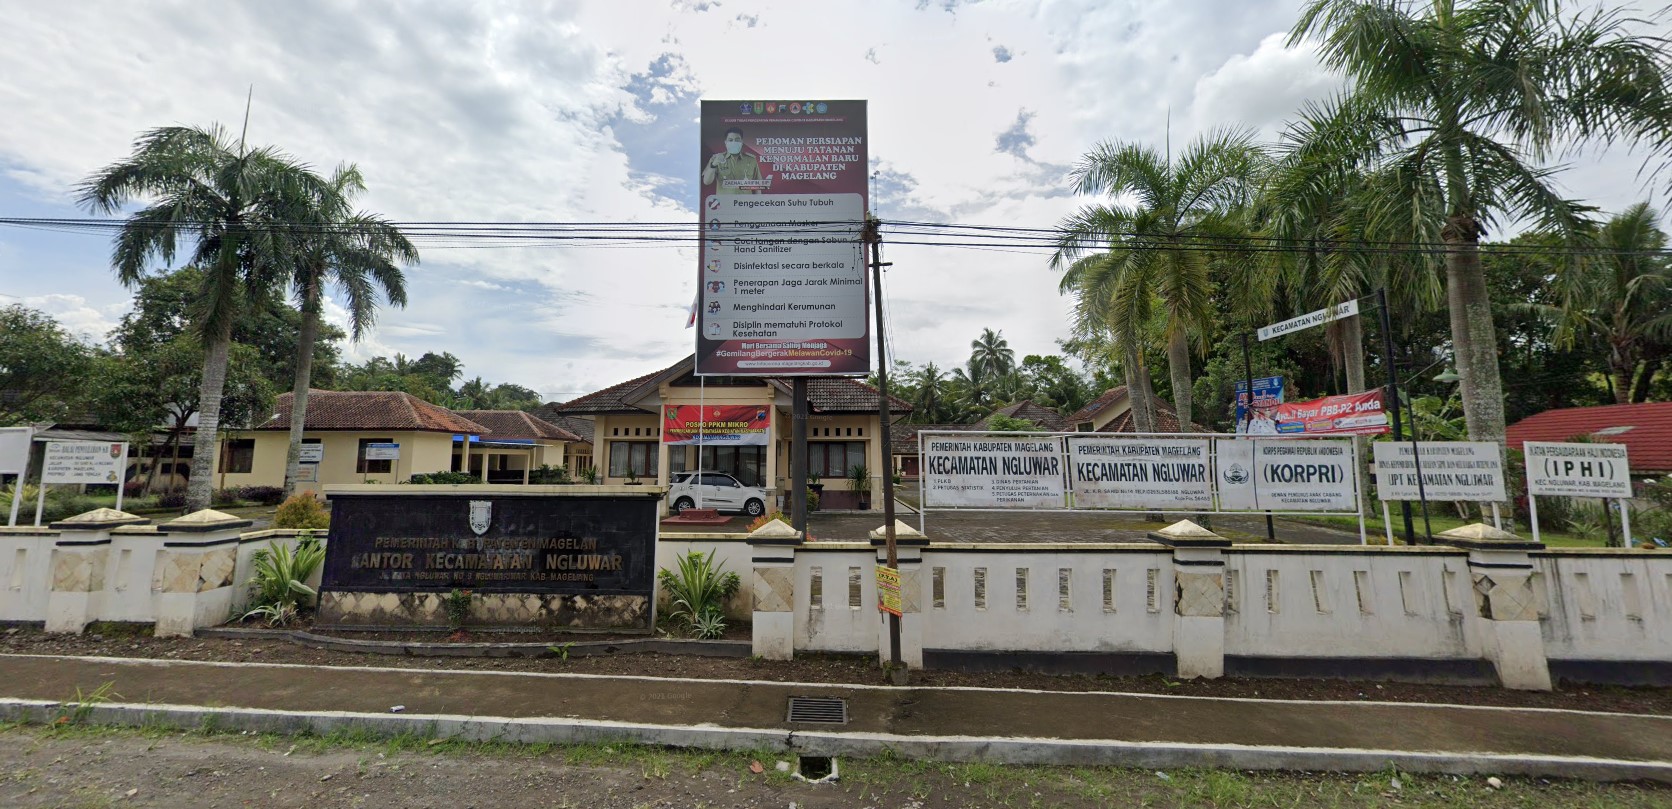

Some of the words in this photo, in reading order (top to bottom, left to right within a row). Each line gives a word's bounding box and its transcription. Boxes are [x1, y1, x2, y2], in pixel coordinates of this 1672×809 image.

[756, 137, 804, 145] PEDOMAN
[764, 146, 804, 154] MENUJU
[782, 172, 836, 180] MAGELANG
[734, 200, 785, 208] Pengecekan
[734, 280, 778, 288] Penerapan
[781, 279, 802, 287] Jaga
[805, 278, 827, 286] Jarak
[733, 303, 785, 312] Menghindari
[733, 322, 762, 330] Disiplin
[1272, 319, 1311, 334] KECAMATAN
[716, 350, 852, 358] #GemilangBergerakMelawanCovid-19
[1298, 409, 1318, 420] Bayar
[1321, 403, 1352, 416] PBB-P2
[1355, 400, 1380, 411] Anda
[931, 442, 971, 451] PEMERINTAH
[974, 443, 1012, 452] KABUPATEN
[1015, 443, 1053, 452] MAGELANG
[1079, 446, 1120, 455] PEMERINTAH
[1122, 446, 1160, 455] KABUPATEN
[1263, 447, 1276, 455] KORPS
[1277, 447, 1296, 455] PEGAWAI
[1297, 447, 1318, 455] REPUBLIK
[1318, 447, 1343, 456] INDONESIA
[929, 456, 997, 475] KECAMATAN
[1002, 456, 1059, 475] NGLUWAR
[1078, 463, 1148, 482] KECAMATAN
[1152, 463, 1206, 482] NGLUWAR
[1264, 464, 1343, 483] (KORPRI)
[1388, 474, 1404, 485] UPT
[1407, 474, 1453, 485] KEAMATAN
[1455, 474, 1494, 486] NGLUWAR
[375, 537, 448, 548] PEMERINTAH
[352, 553, 414, 569] KANTOR
[546, 554, 623, 570] NGLUWAR
